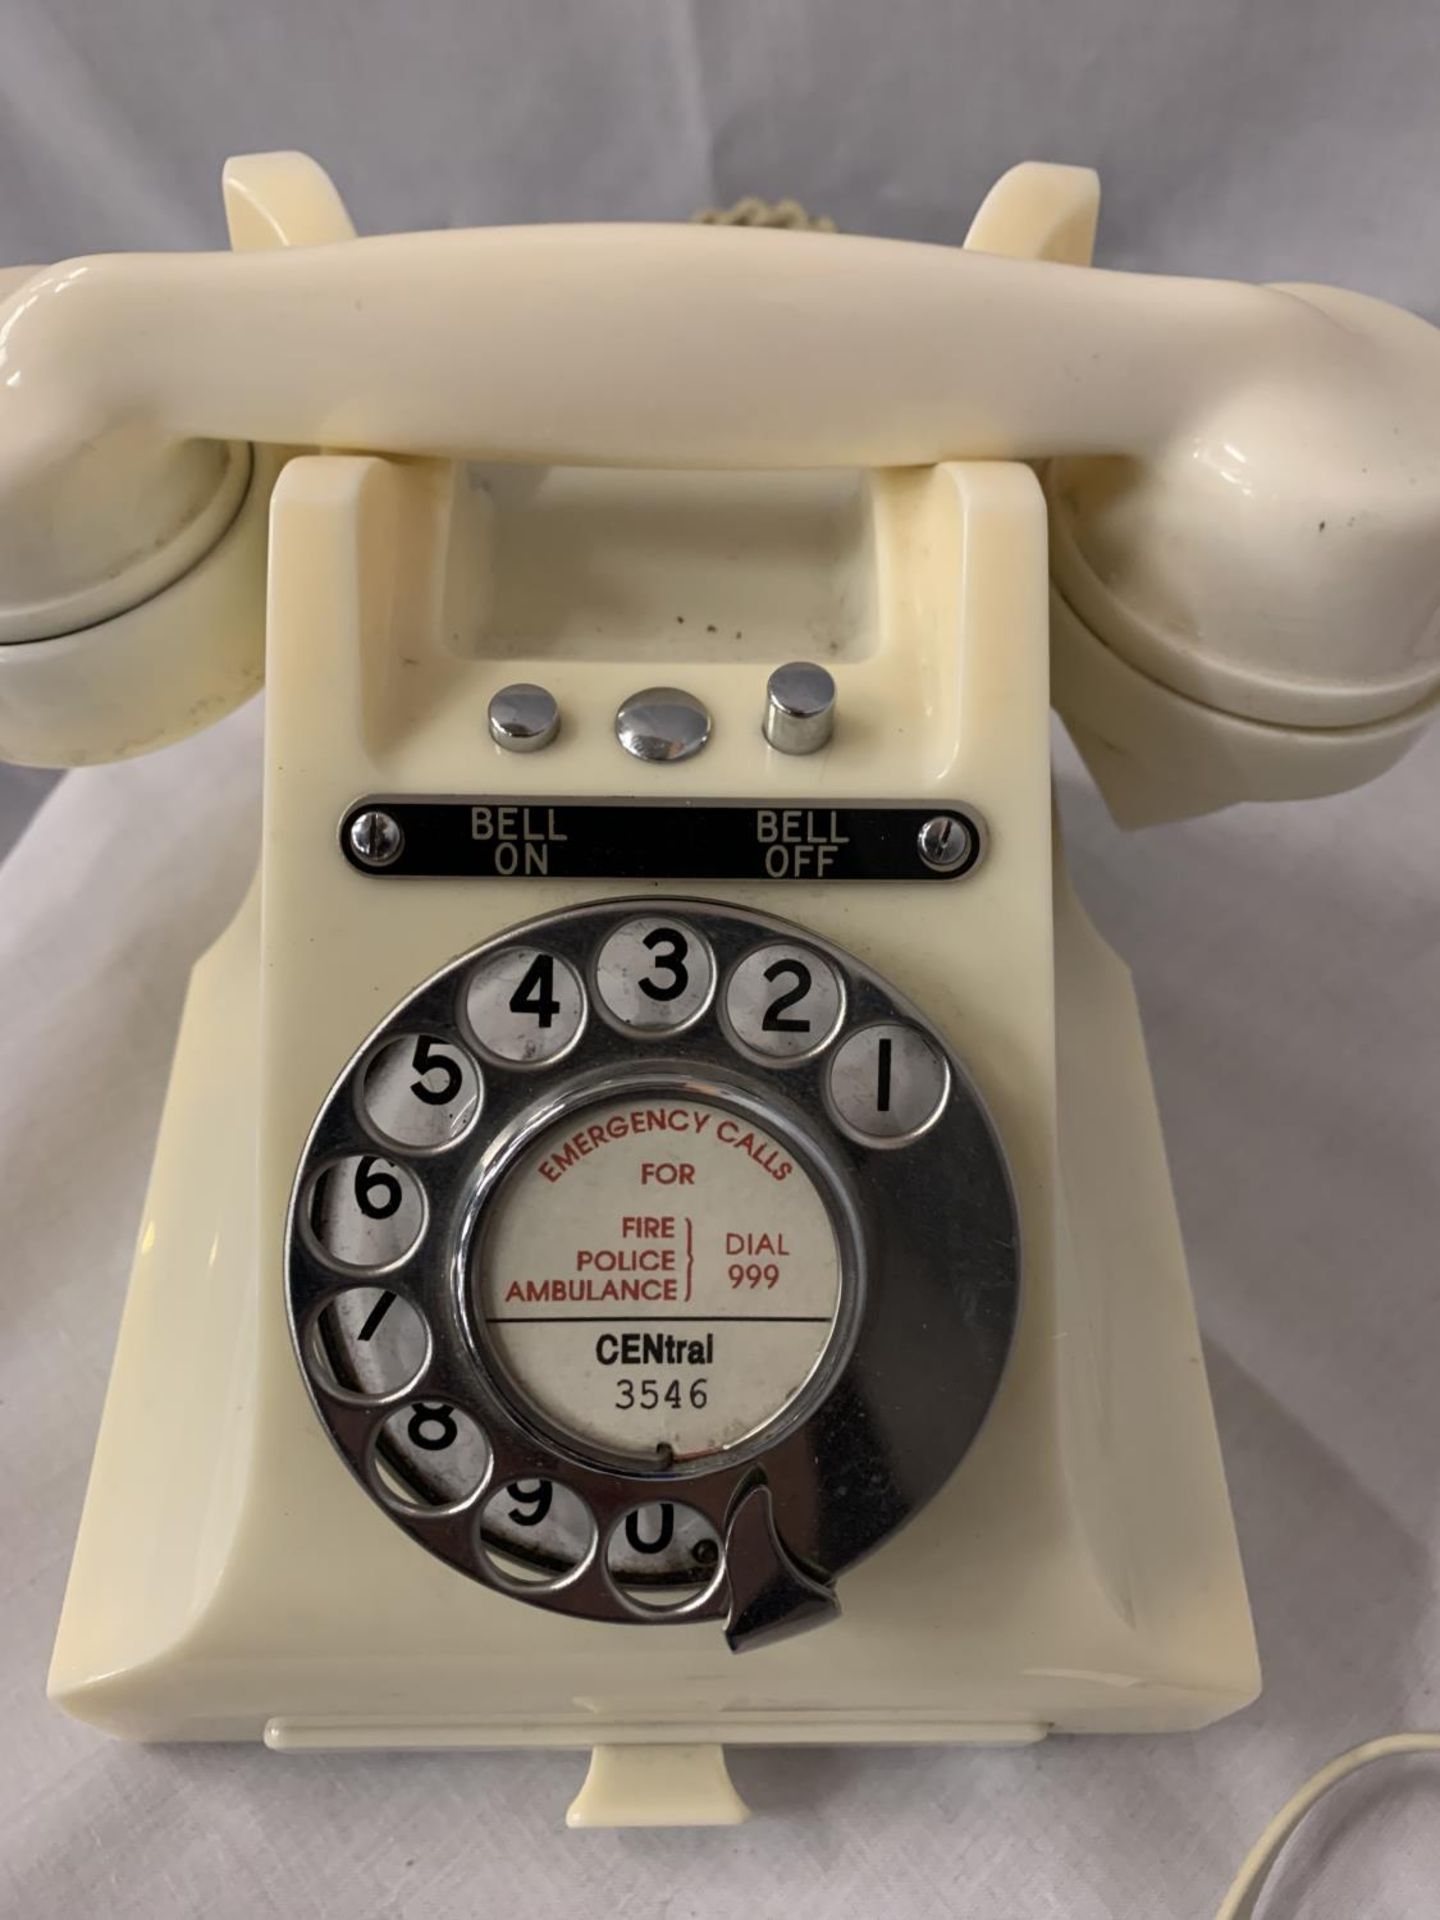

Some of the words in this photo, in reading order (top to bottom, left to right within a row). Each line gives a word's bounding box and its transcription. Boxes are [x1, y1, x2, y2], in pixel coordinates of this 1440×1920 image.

[472, 807, 567, 841] BELL
[756, 811, 850, 844] BELL
[494, 843, 549, 875] ON
[765, 845, 839, 878] OFF
[638, 927, 688, 1001] 3
[509, 953, 560, 1028] 4
[762, 959, 812, 1033] 2
[410, 1033, 462, 1105] 5
[877, 1038, 892, 1111] 1
[538, 1108, 710, 1183] EMERGENCY
[716, 1121, 793, 1182] CALLS
[354, 1155, 402, 1219] 6
[641, 1163, 695, 1185] FOR
[622, 1217, 675, 1238] FIRE
[726, 1233, 790, 1255] DIAL
[576, 1250, 676, 1271] POLICE
[728, 1264, 780, 1289] 999
[505, 1279, 678, 1302] AMBULANCE
[595, 1333, 714, 1365] CENtral
[615, 1378, 708, 1410] 3546
[407, 1401, 458, 1451] 8
[506, 1479, 553, 1526] 9
